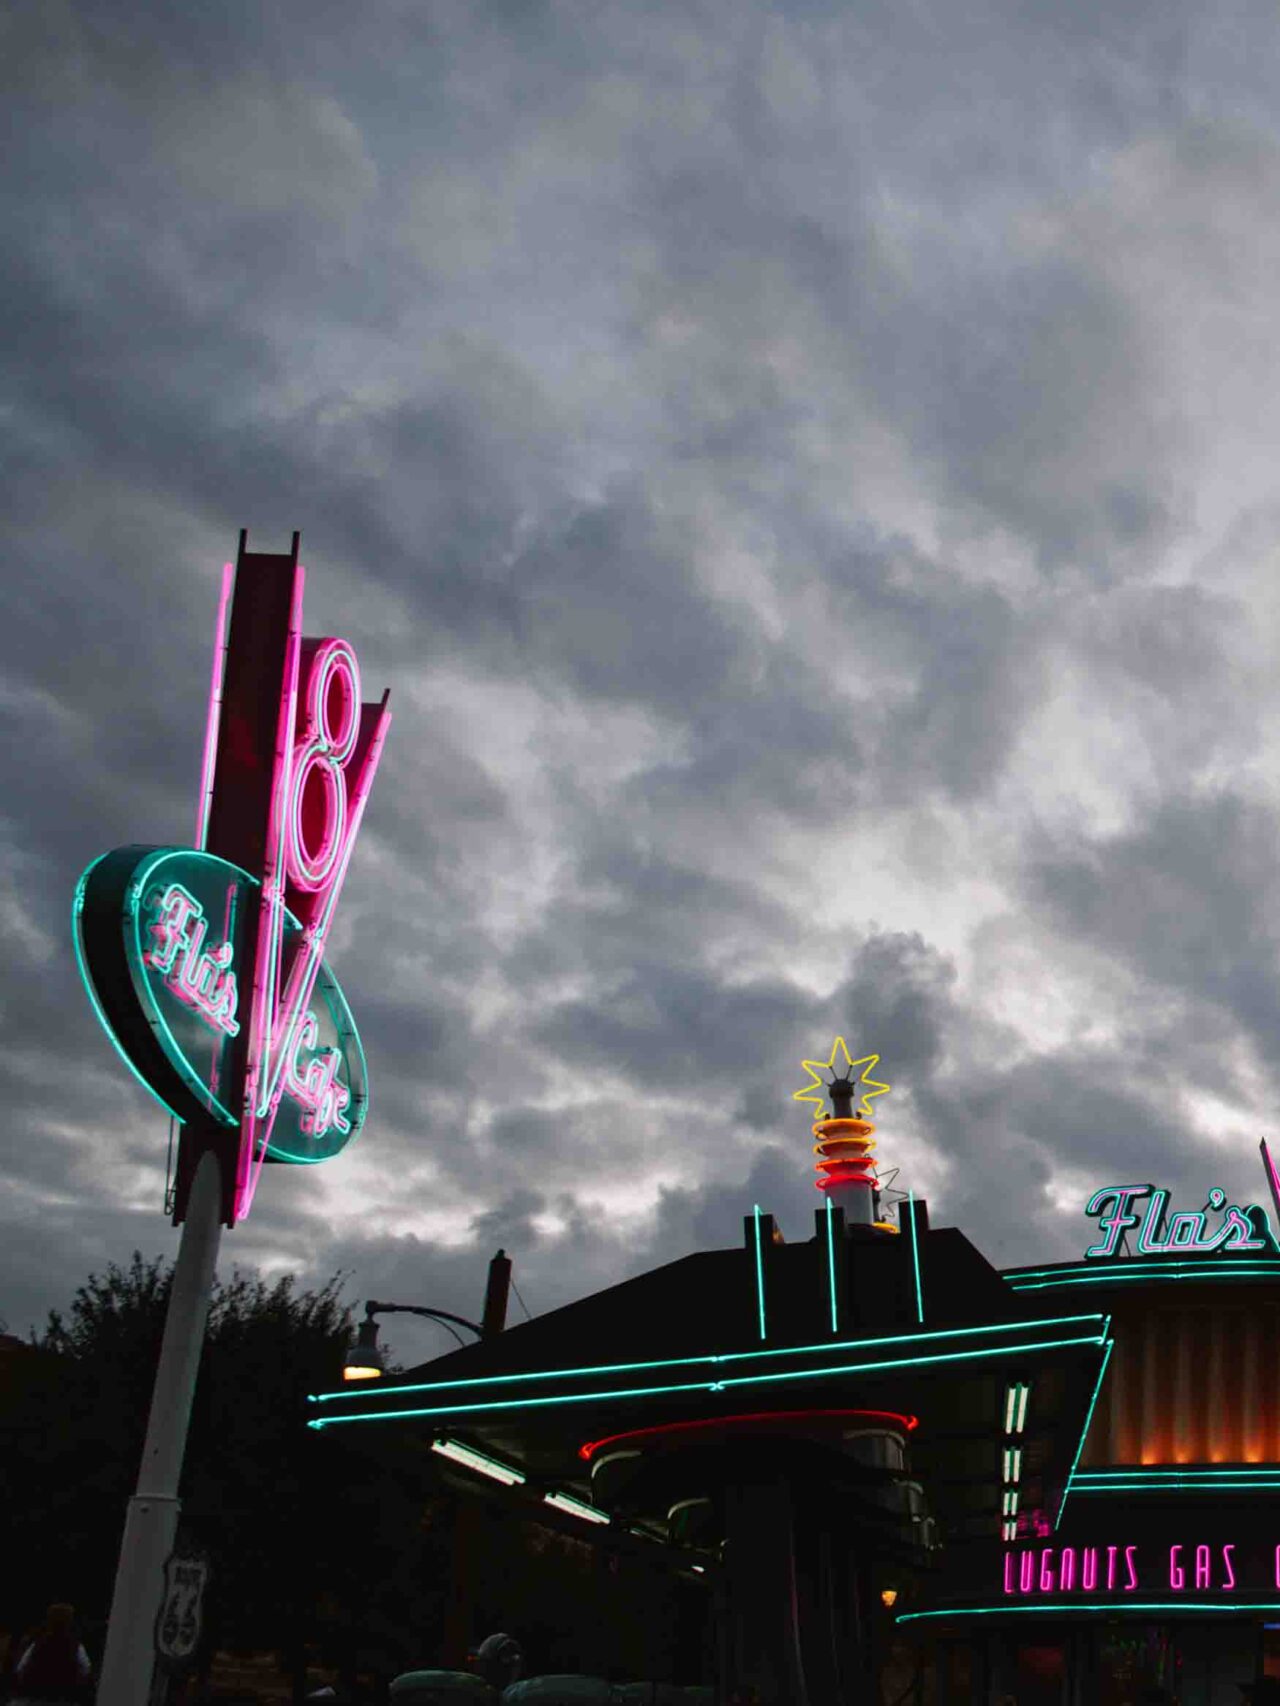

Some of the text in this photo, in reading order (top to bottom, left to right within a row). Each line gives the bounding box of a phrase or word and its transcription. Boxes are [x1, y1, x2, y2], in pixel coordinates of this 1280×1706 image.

[150, 882, 241, 1038] Flo's
[287, 1010, 352, 1139] Cafe
[1085, 1183, 1267, 1259] Flo's
[1003, 1546, 1138, 1594] LUGNUTS
[1169, 1544, 1236, 1591] GAS
